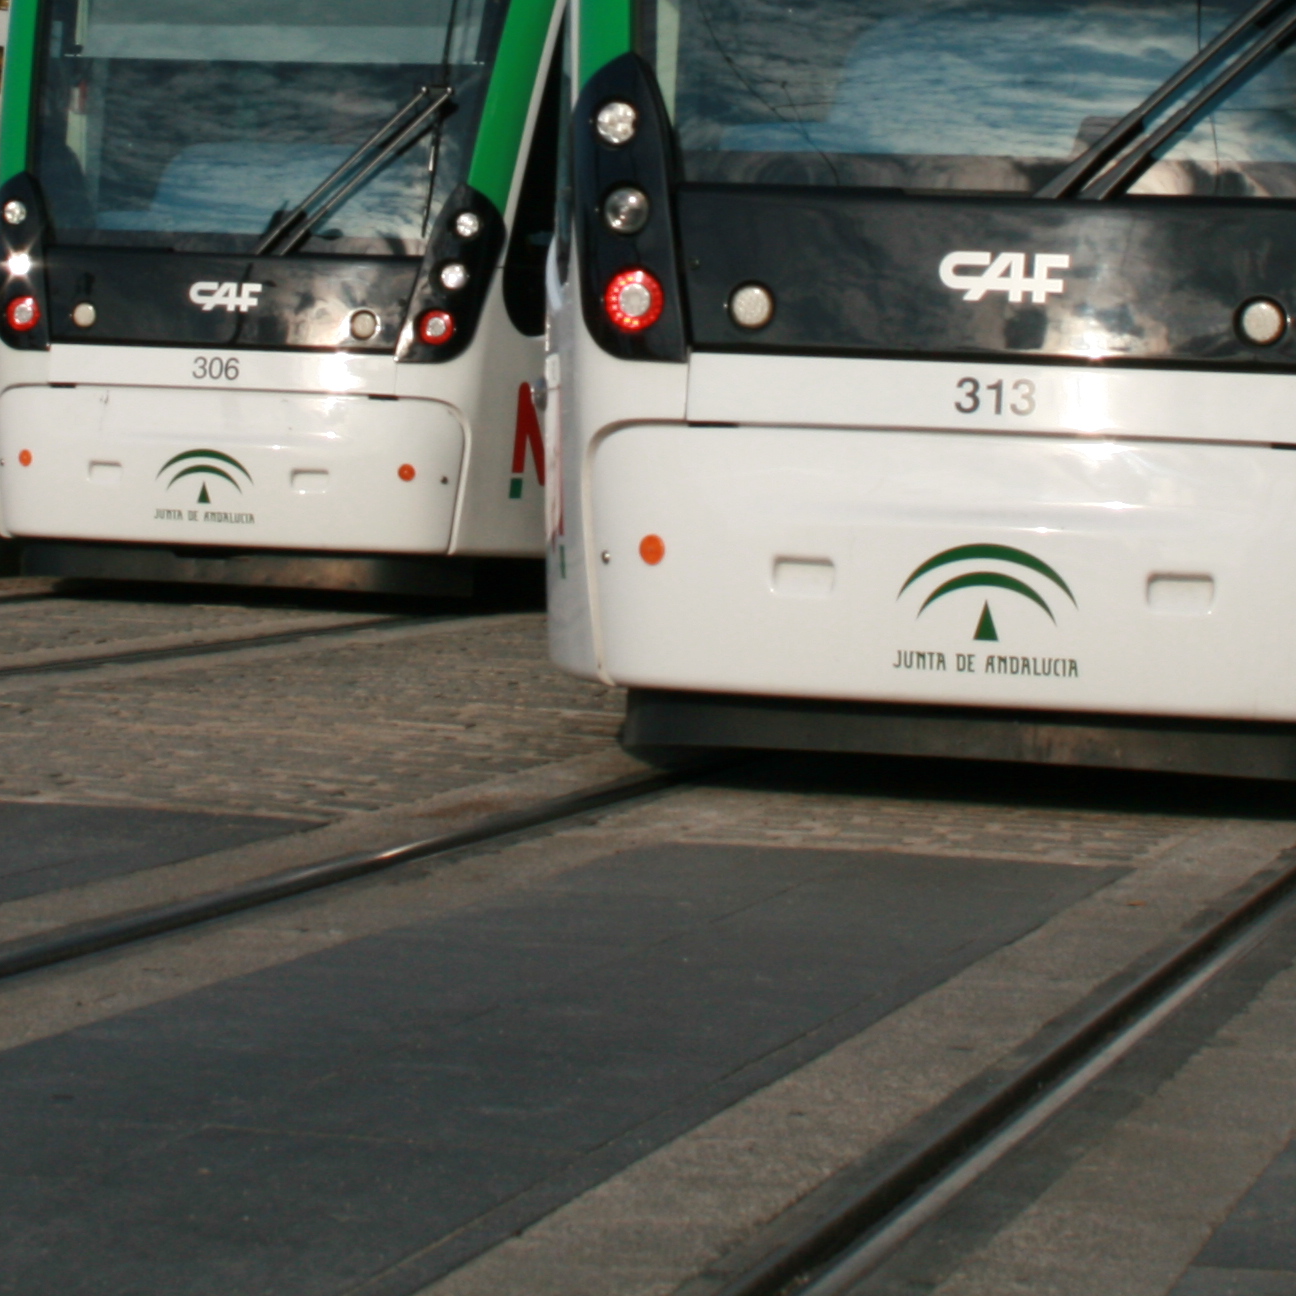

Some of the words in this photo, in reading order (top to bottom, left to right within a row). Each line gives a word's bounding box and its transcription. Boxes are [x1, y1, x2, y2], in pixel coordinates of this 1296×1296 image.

[939, 250, 1071, 304] CAF
[189, 281, 263, 313] CAF
[192, 356, 240, 381] 306
[953, 376, 1037, 417] 313
[154, 508, 183, 521] JUNTA
[188, 510, 199, 522] DE
[892, 649, 947, 672] JUNTA
[956, 652, 976, 674] DE
[985, 654, 1079, 678] ANDALUCIA
